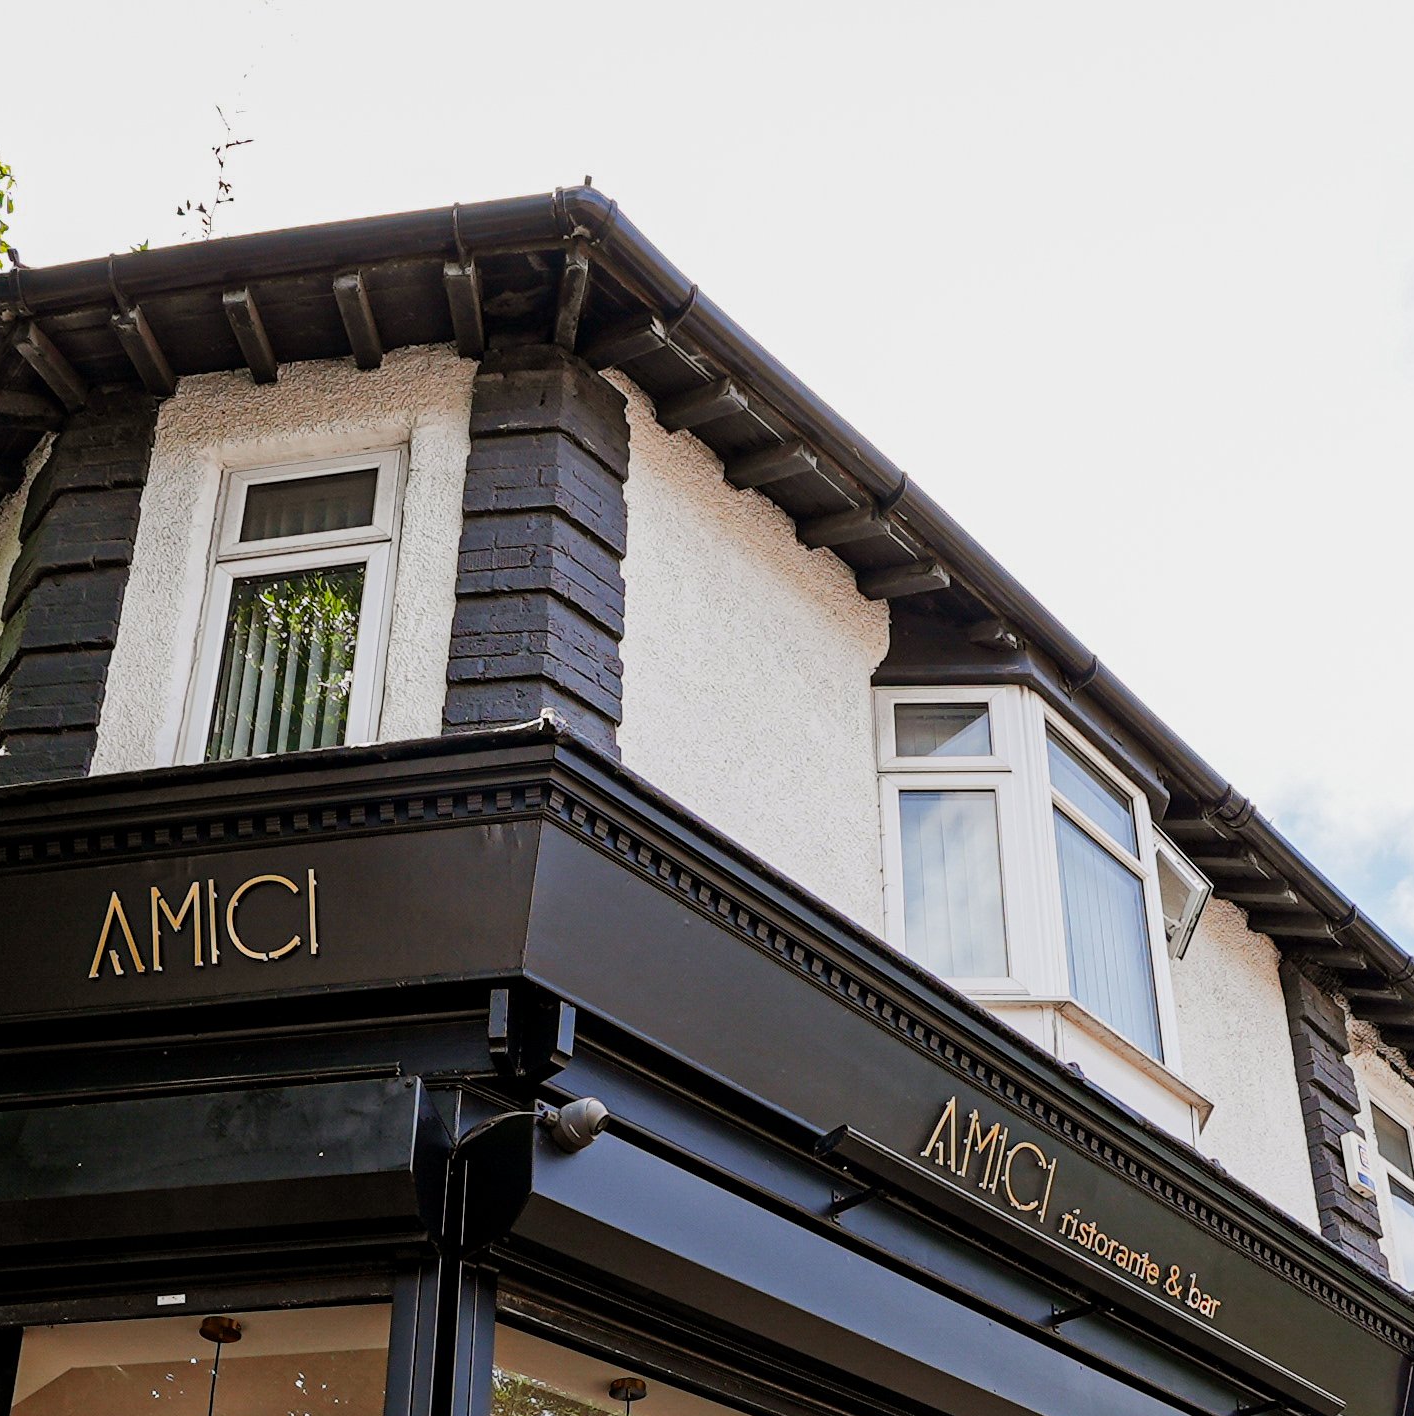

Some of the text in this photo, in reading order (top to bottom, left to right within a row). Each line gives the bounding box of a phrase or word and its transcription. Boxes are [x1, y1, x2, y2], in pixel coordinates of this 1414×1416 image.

[88, 868, 320, 979] AMICI
[919, 1095, 1222, 1320] AMICI ristorante & bar
